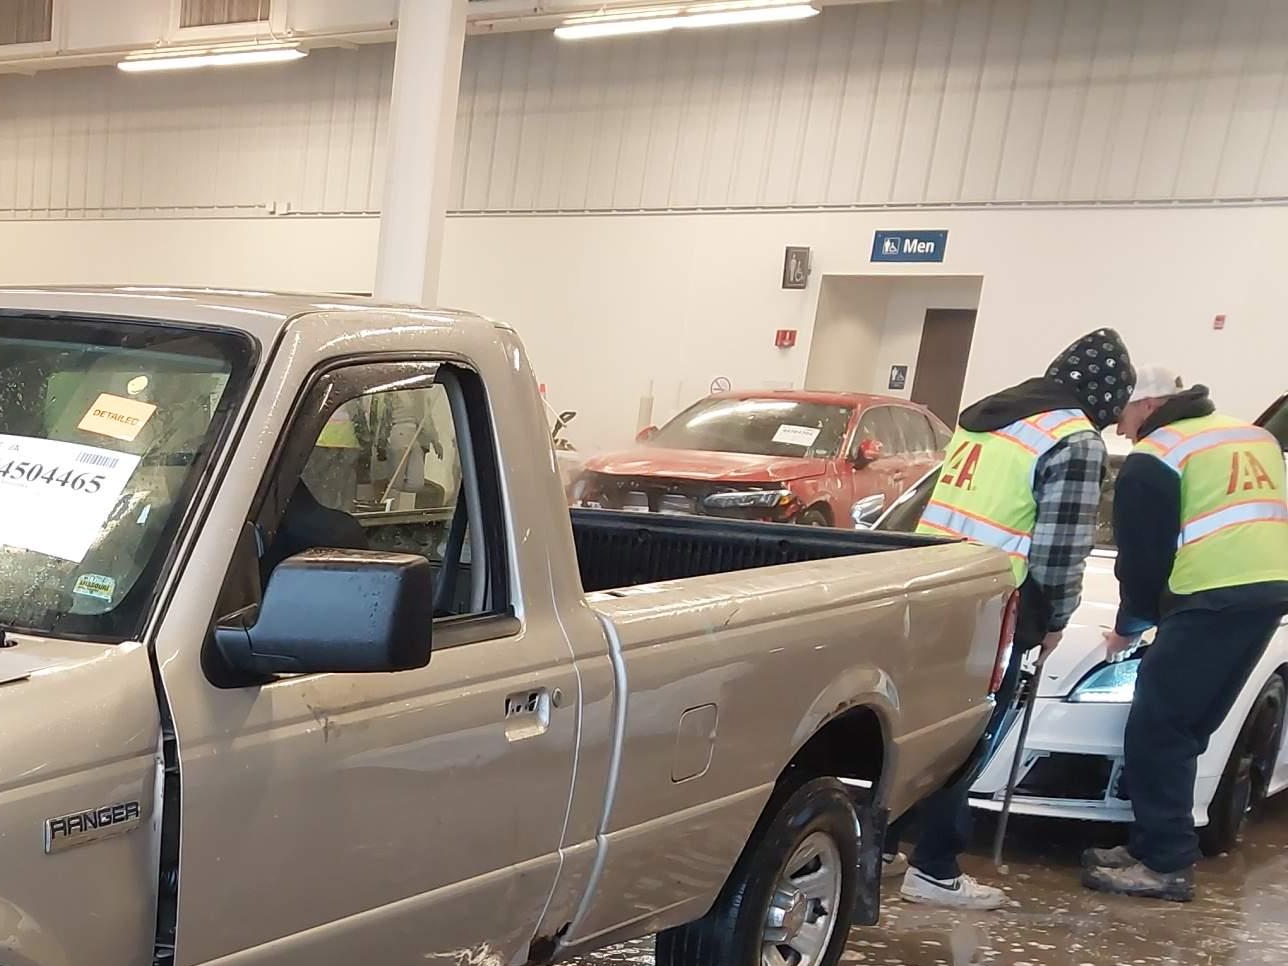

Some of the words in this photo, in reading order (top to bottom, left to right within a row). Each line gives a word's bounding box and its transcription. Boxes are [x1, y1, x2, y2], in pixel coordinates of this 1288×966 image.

[903, 238, 935, 254] Men
[92, 408, 140, 426] DETAILED
[50, 801, 140, 840] RANGER
